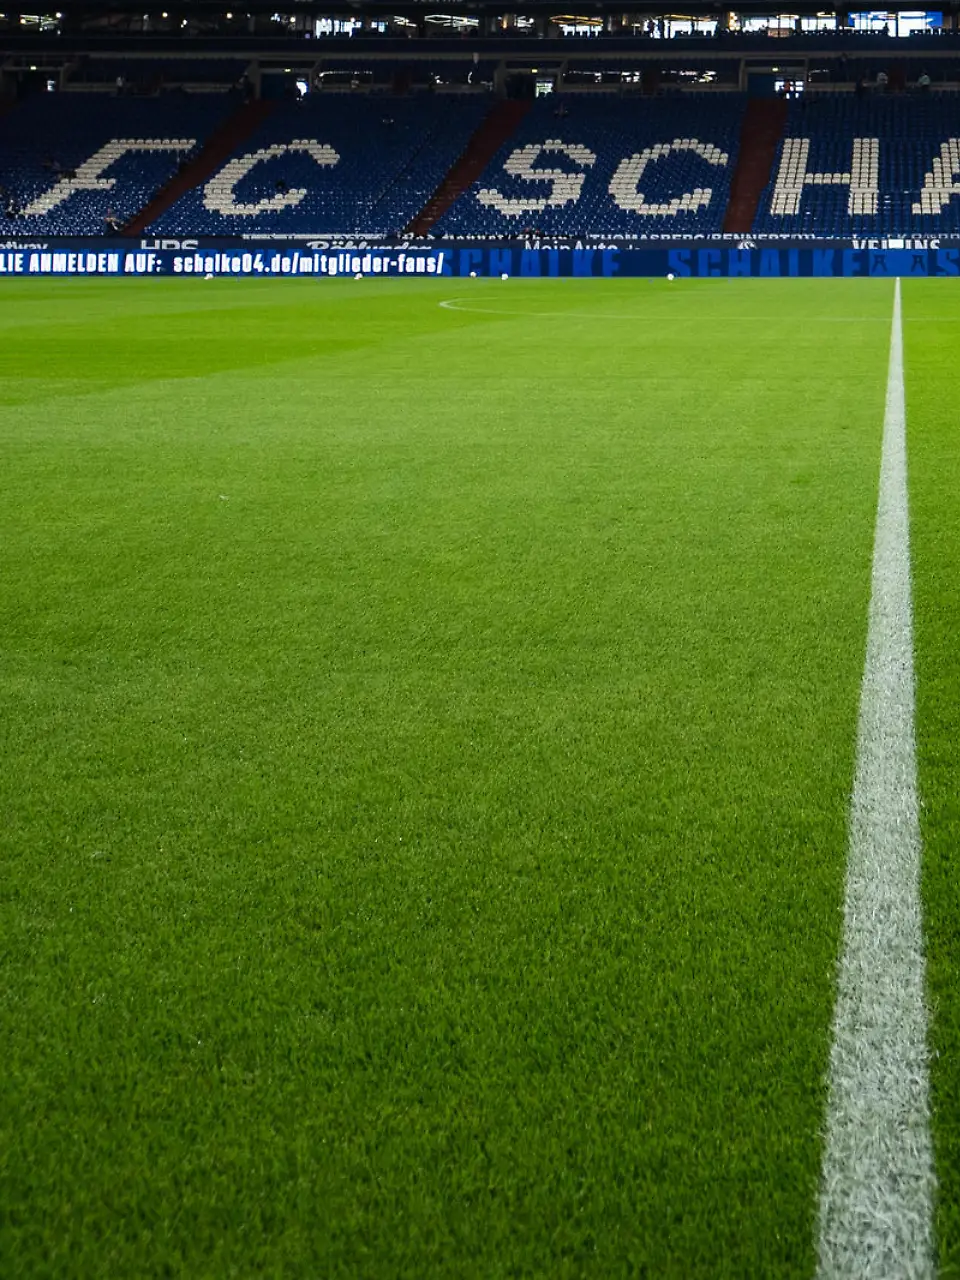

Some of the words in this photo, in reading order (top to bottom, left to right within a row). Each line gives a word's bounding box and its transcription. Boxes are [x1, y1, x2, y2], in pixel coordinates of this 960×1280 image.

[19, 138, 341, 217] FC
[852, 239, 940, 250] VELINS
[29, 253, 119, 273] ANMELDEN
[124, 253, 162, 273] AUF:
[173, 252, 444, 276] schalke04.de/mitglieder-fans/
